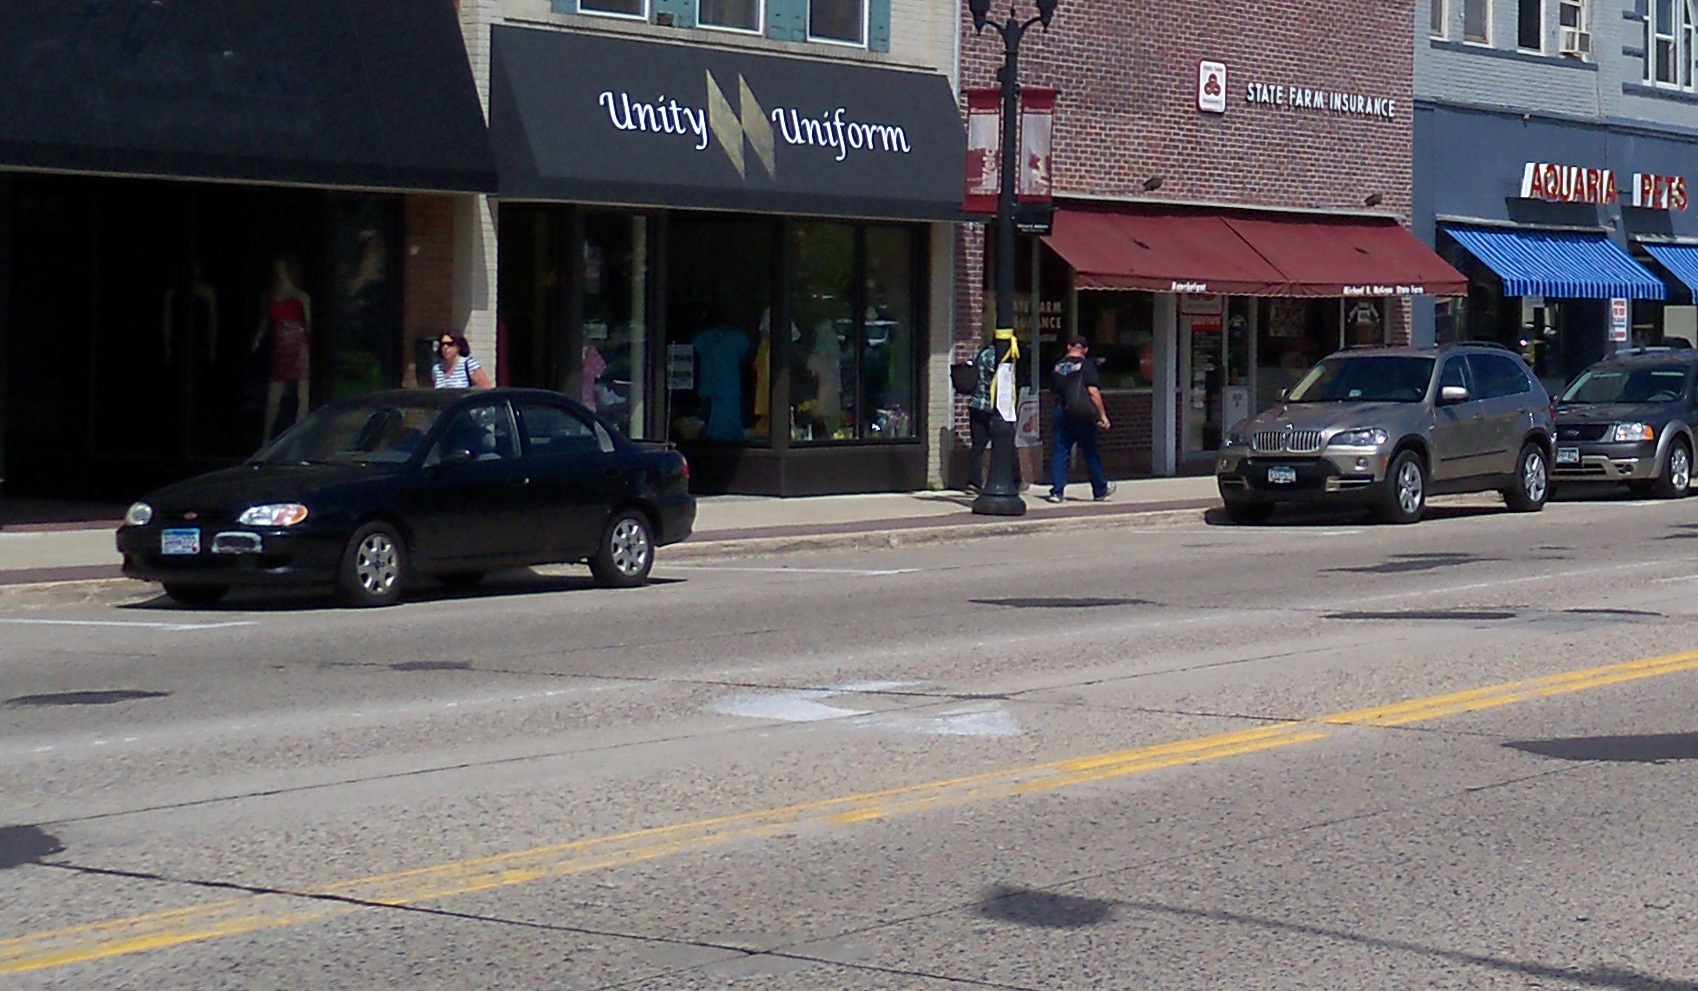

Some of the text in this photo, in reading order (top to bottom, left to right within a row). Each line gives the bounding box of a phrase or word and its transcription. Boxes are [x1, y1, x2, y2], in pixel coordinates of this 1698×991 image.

[1246, 82, 1395, 117] STATE FARM INSURANCE
[599, 91, 911, 161] Unity Uniform
[1529, 162, 1689, 211] AQUARIA PETS
[1040, 301, 1062, 313] ARM
